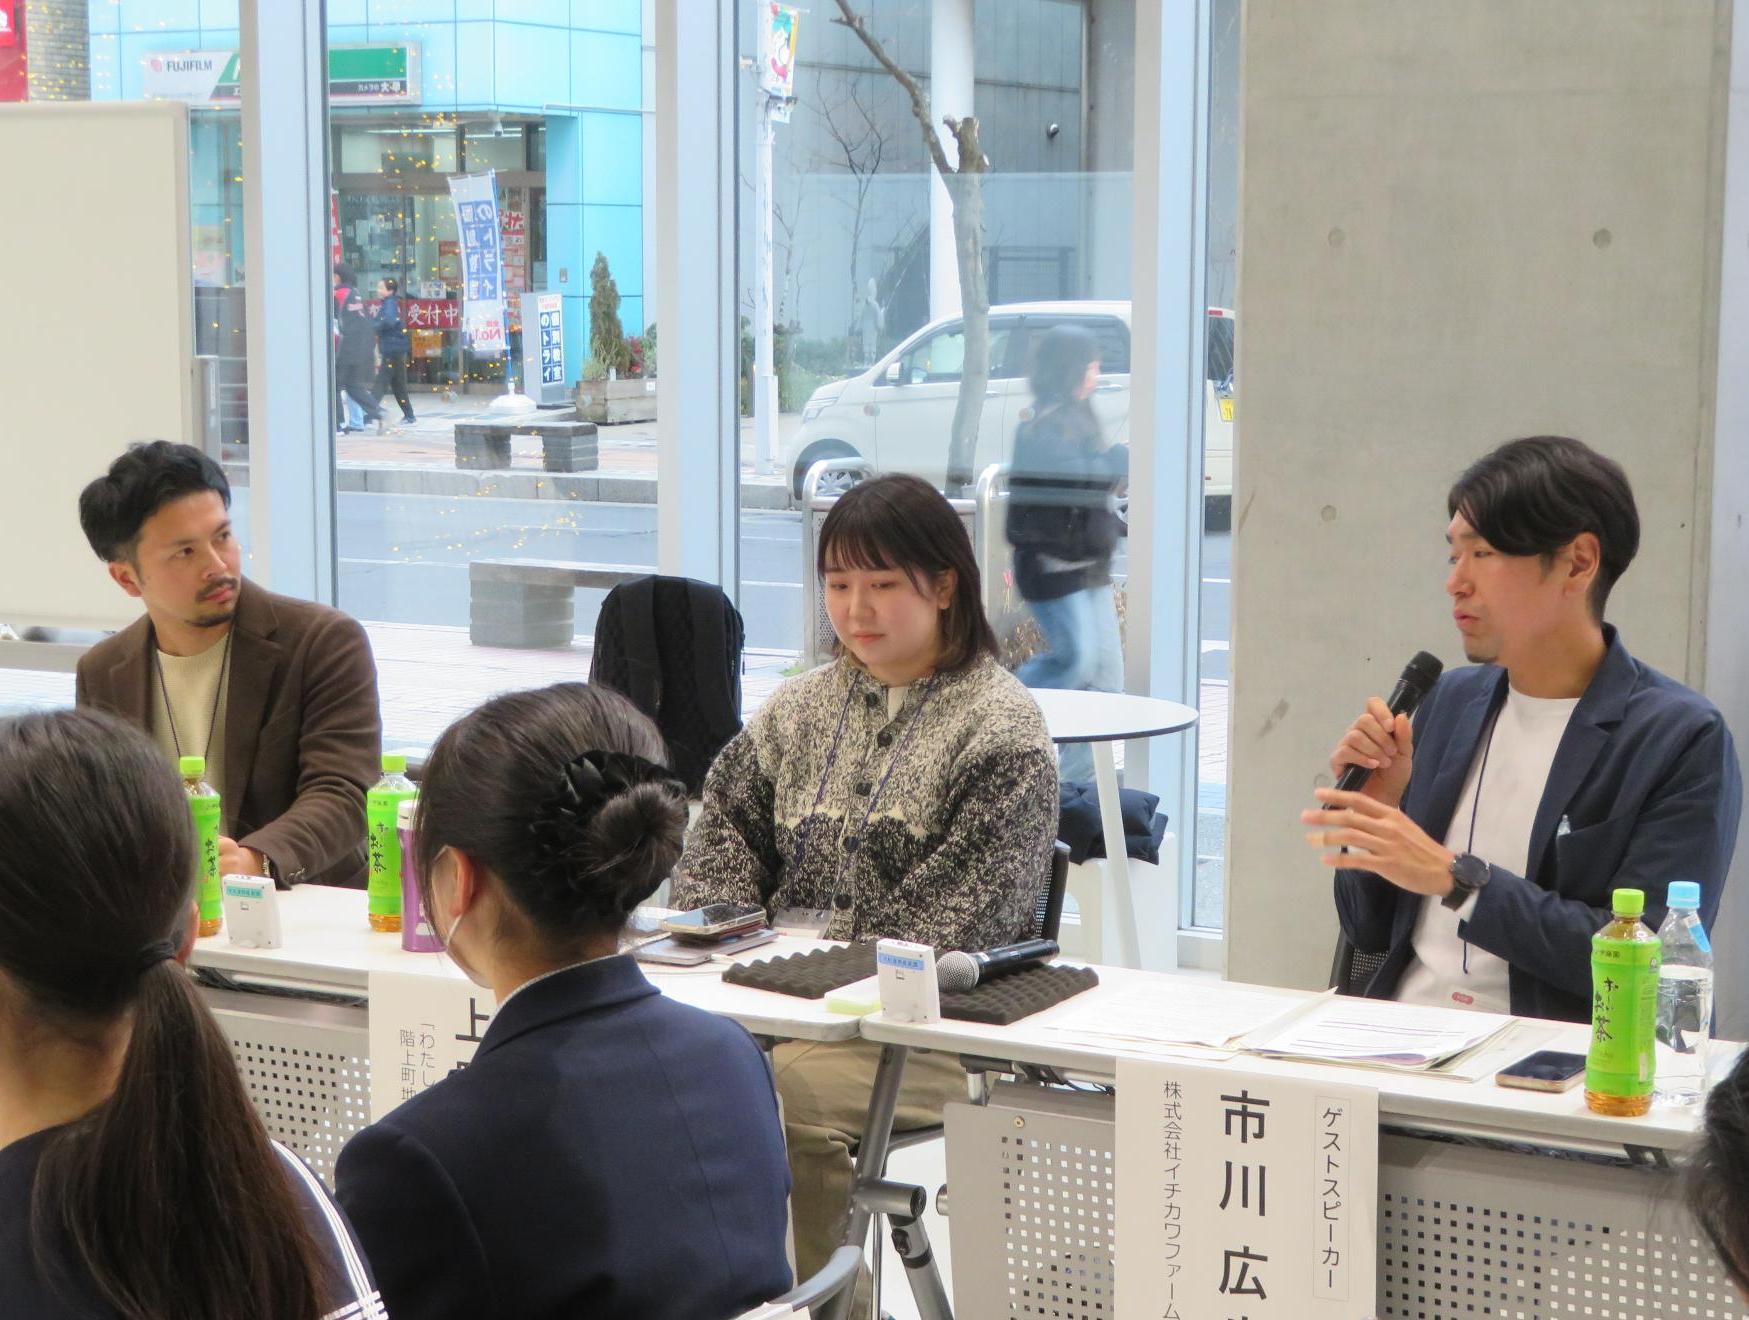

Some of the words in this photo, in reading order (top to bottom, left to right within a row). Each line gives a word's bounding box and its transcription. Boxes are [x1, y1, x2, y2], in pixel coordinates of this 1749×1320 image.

[166, 59, 212, 72] FUJIFILM
[407, 303, 459, 326] 受付中
[540, 313, 551, 382] のトライ
[399, 1029, 417, 1100] 階上町地
[1163, 1080, 1182, 1320] 株式会社イチカワファーム
[1218, 1089, 1270, 1320] 市川広
[1322, 1107, 1343, 1288] ゲストスピーカー
